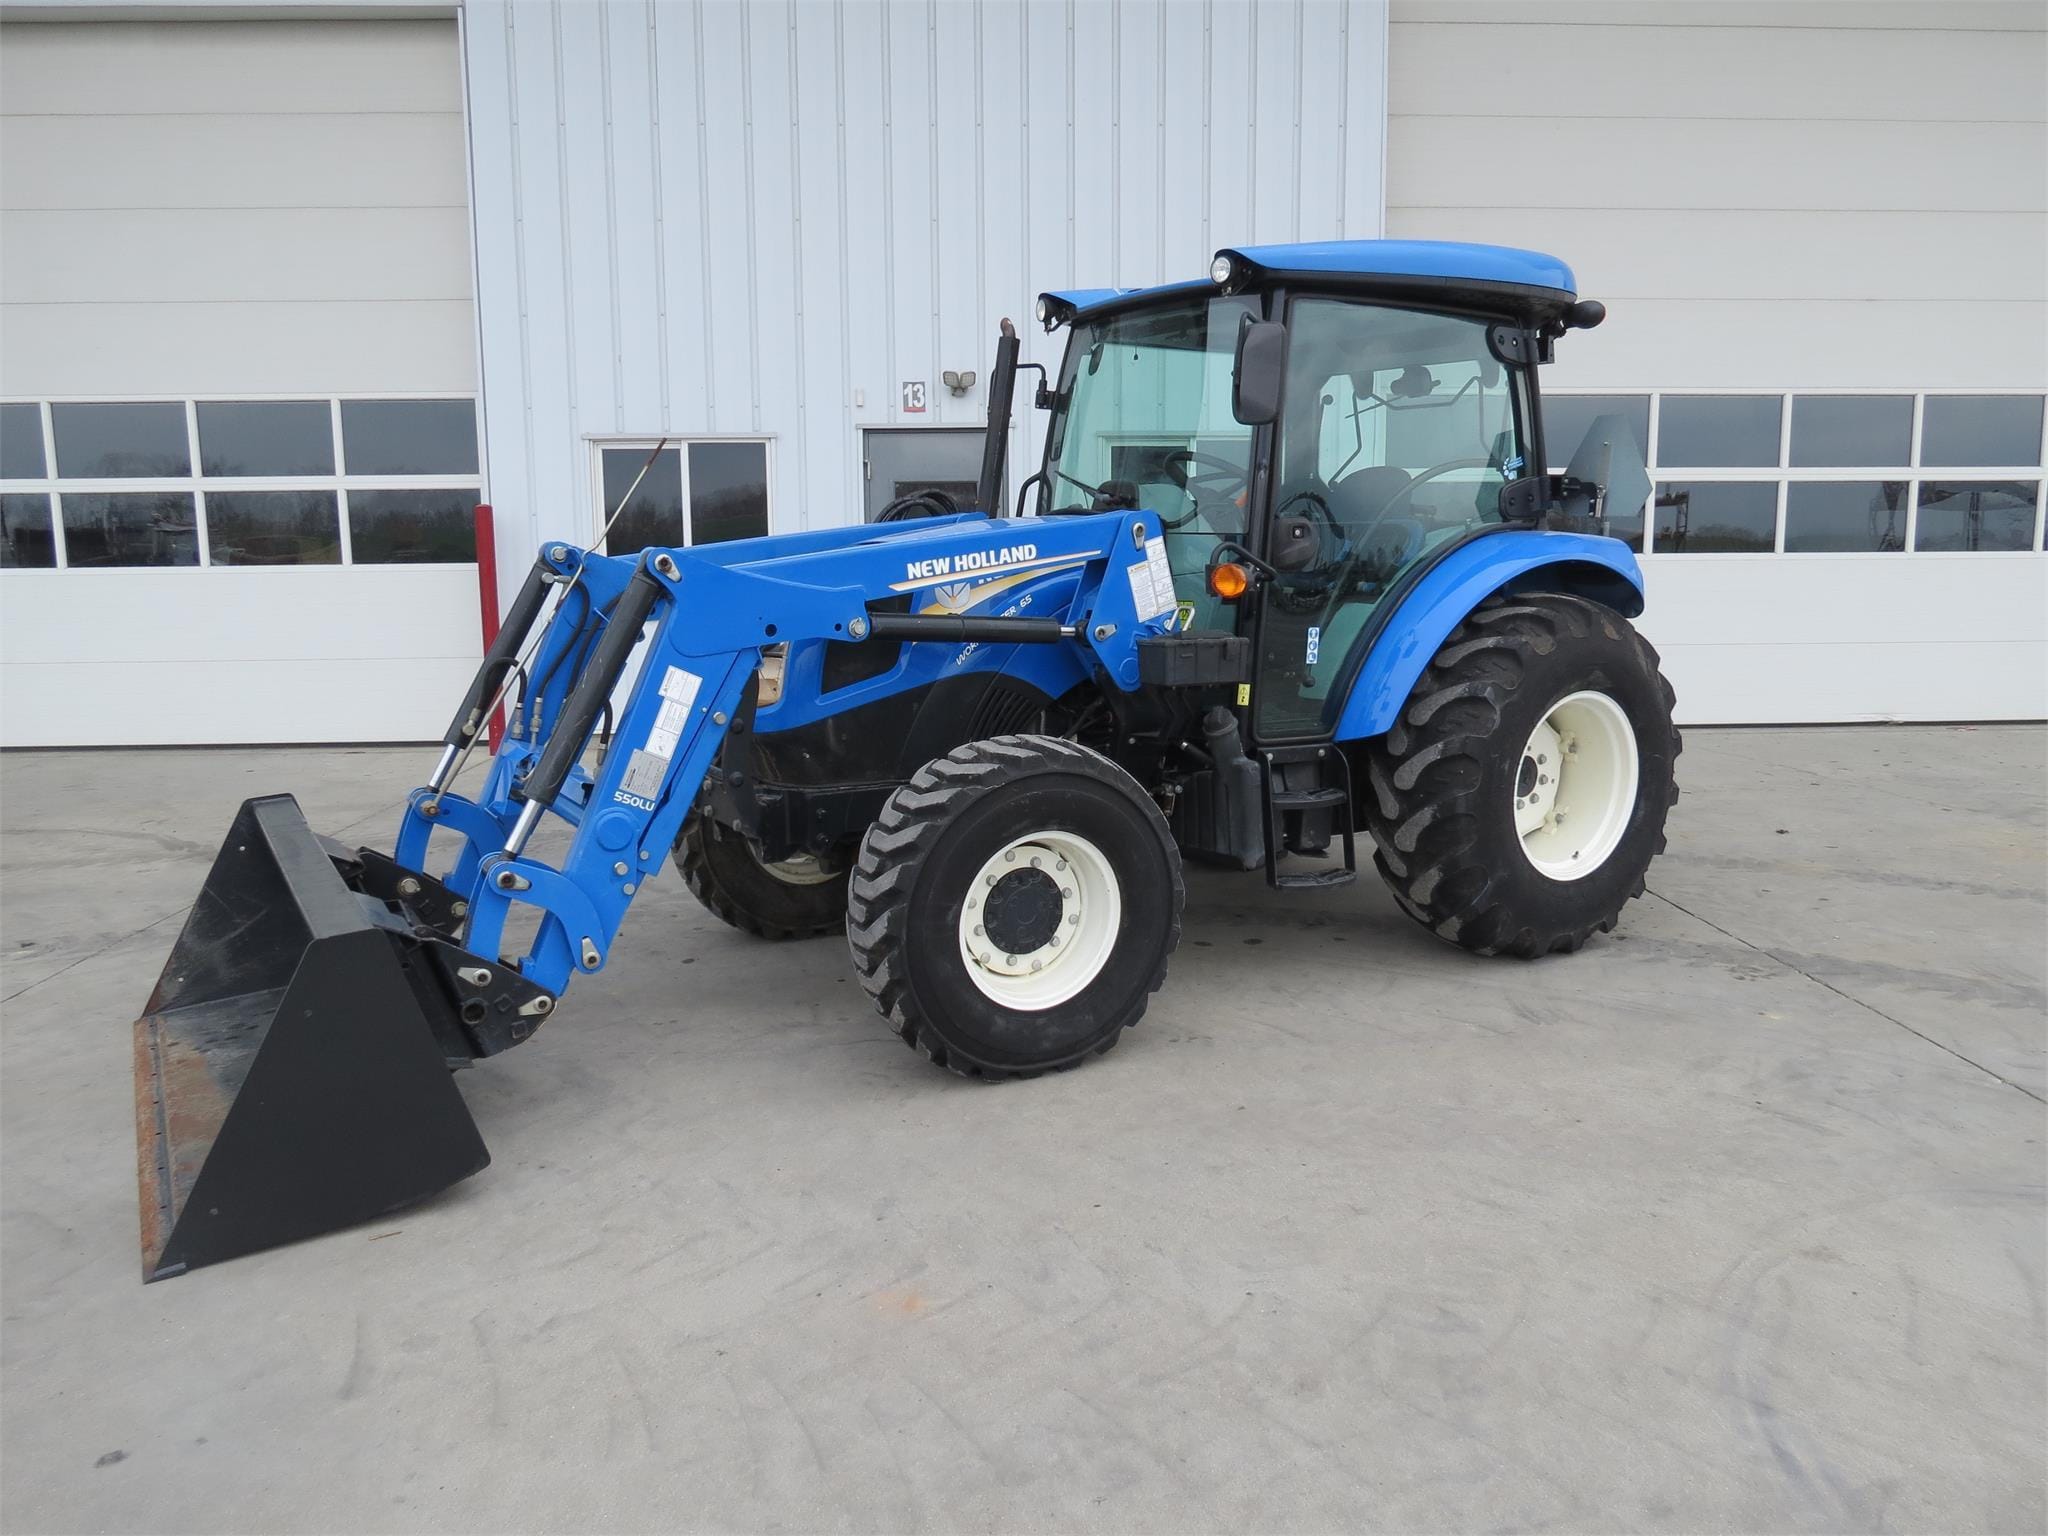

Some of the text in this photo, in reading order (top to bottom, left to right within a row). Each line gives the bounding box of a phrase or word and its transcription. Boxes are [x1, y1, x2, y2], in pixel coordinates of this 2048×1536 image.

[903, 383, 925, 408] 13
[907, 544, 1037, 580] NEW HOLLAND
[1020, 594, 1032, 608] 65
[613, 790, 656, 812] 550LU
